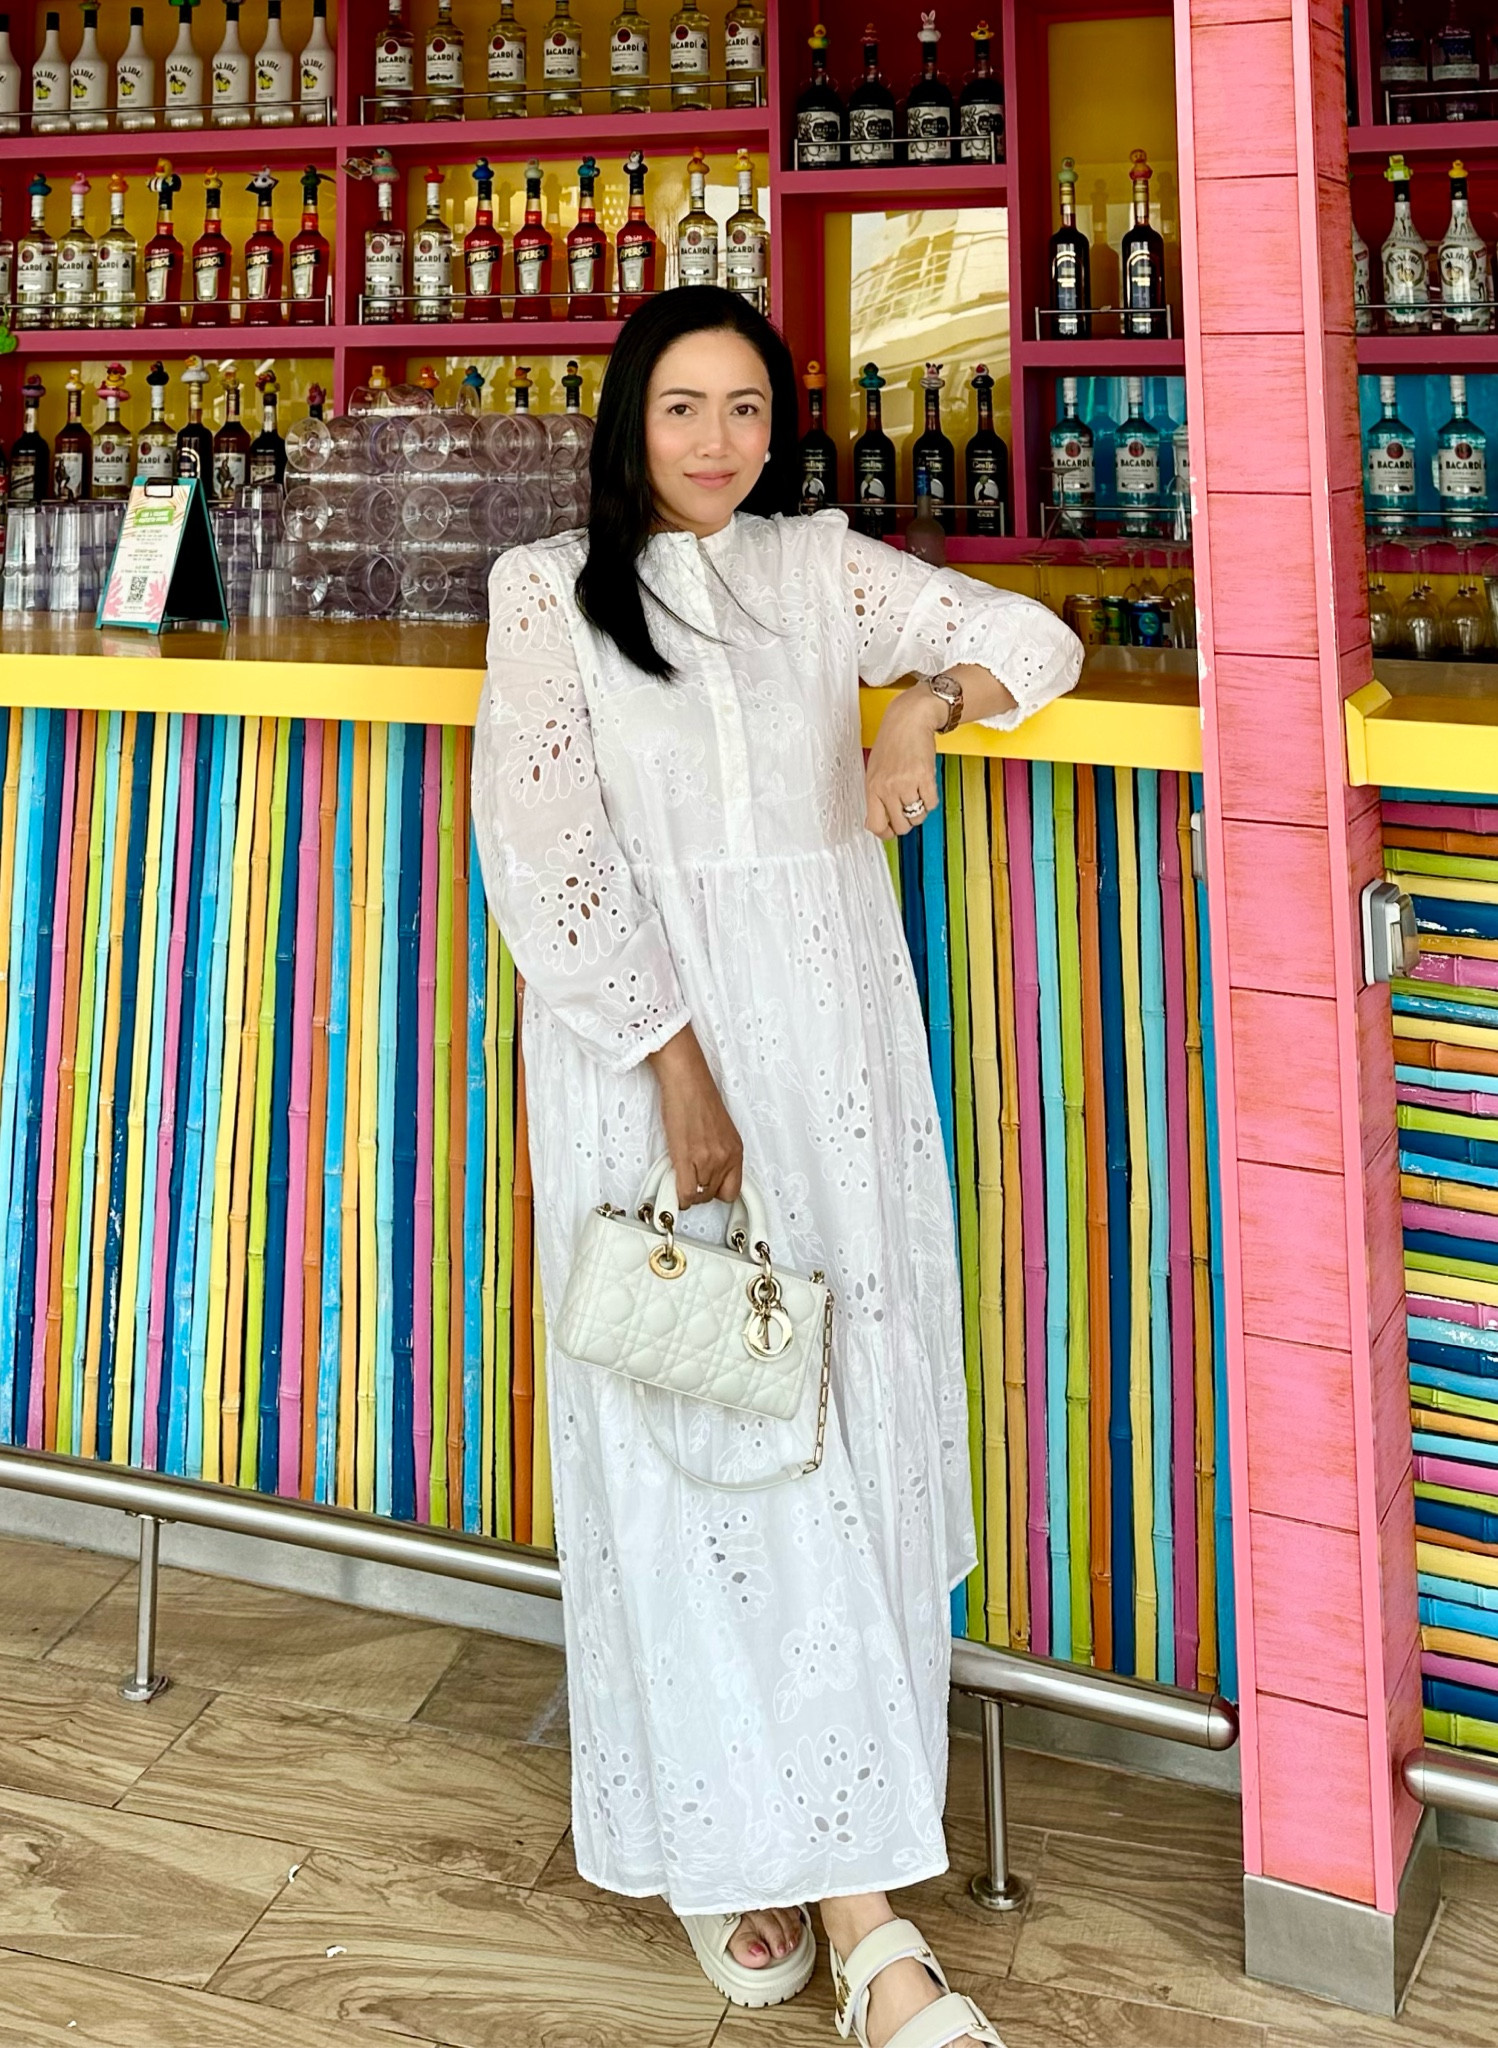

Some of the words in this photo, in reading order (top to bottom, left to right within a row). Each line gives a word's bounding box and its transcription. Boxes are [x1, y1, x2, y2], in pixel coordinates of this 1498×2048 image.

[1120, 458, 1154, 468] BACARDÍ
[1377, 459, 1412, 470] BACARDÍ
[1446, 460, 1482, 470] BACARDÍ
